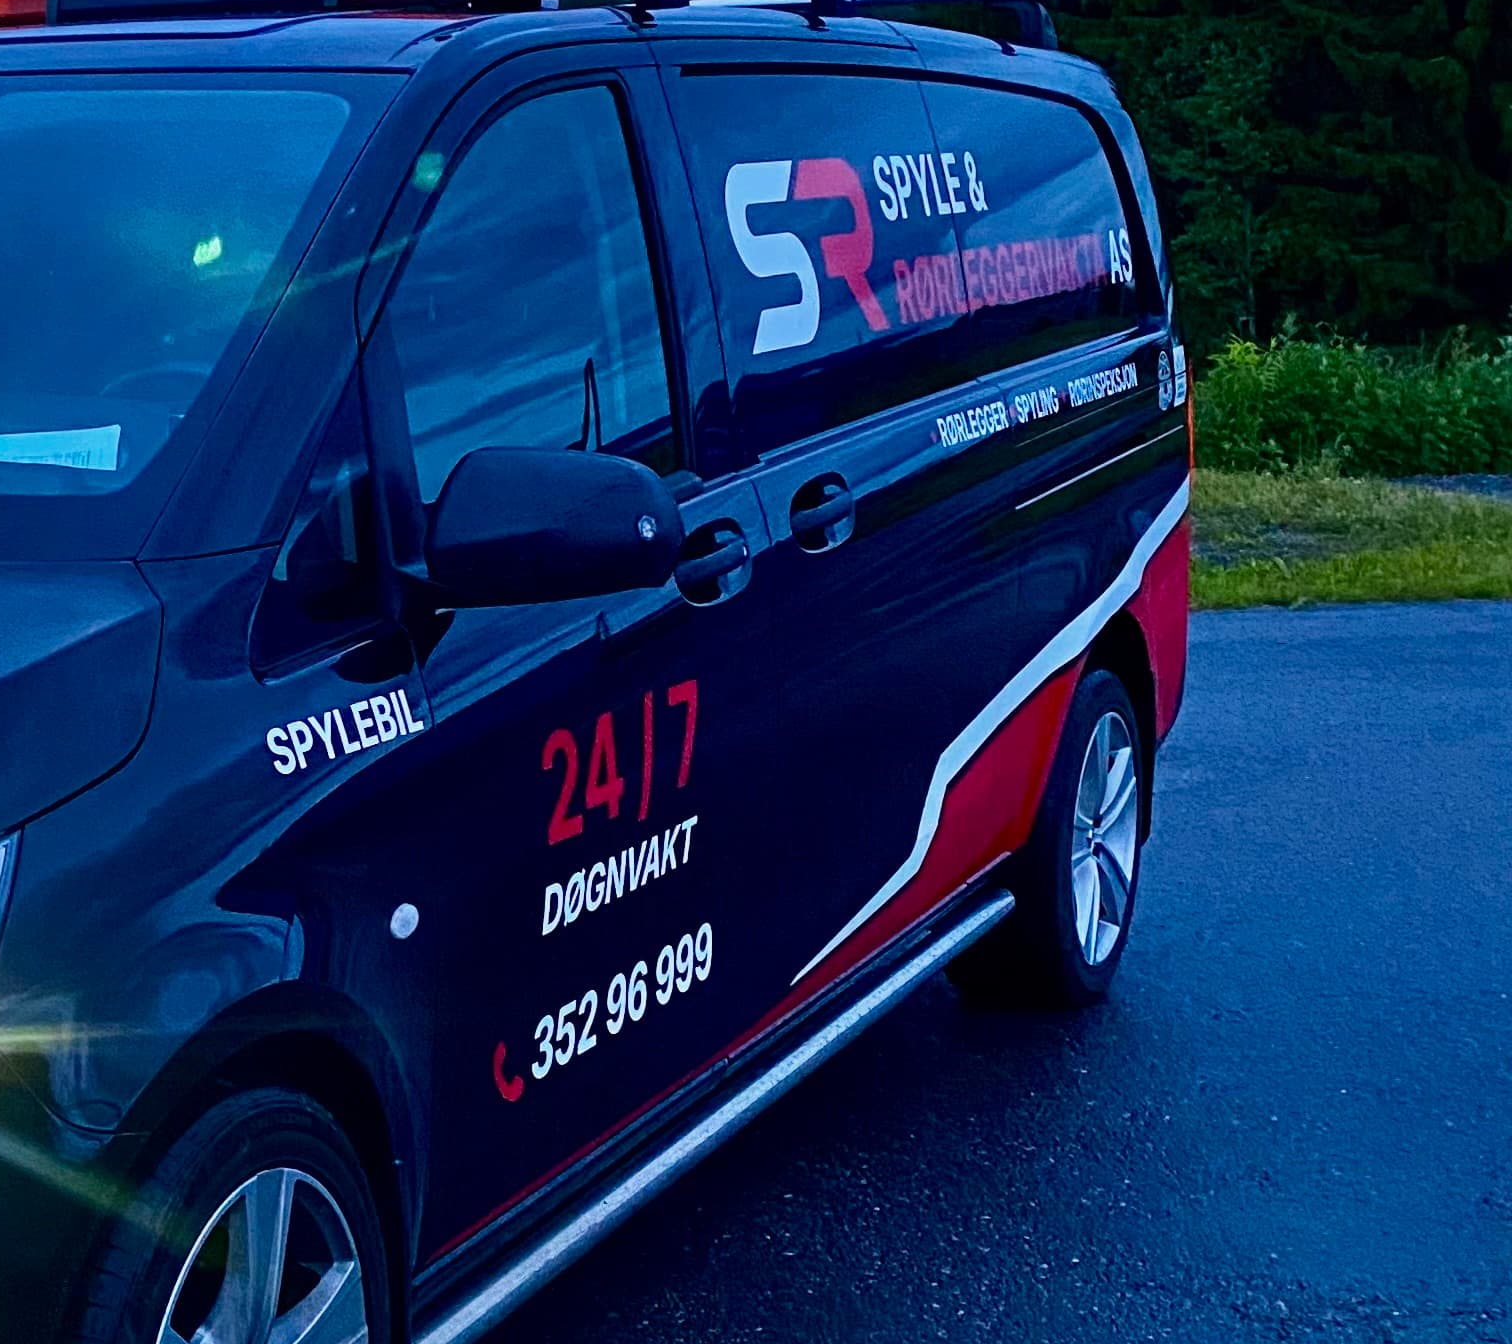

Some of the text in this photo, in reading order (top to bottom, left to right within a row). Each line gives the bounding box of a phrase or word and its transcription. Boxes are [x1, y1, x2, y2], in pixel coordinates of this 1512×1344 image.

[873, 151, 988, 221] SPYLE &
[1108, 228, 1134, 284] AS
[937, 401, 1009, 448] RØRLEGGER
[1015, 387, 1060, 426] SPYLING
[266, 689, 425, 775] SPYLEBIL
[542, 816, 699, 936] DØGNVAKT
[531, 922, 714, 1080] 352 96 999
